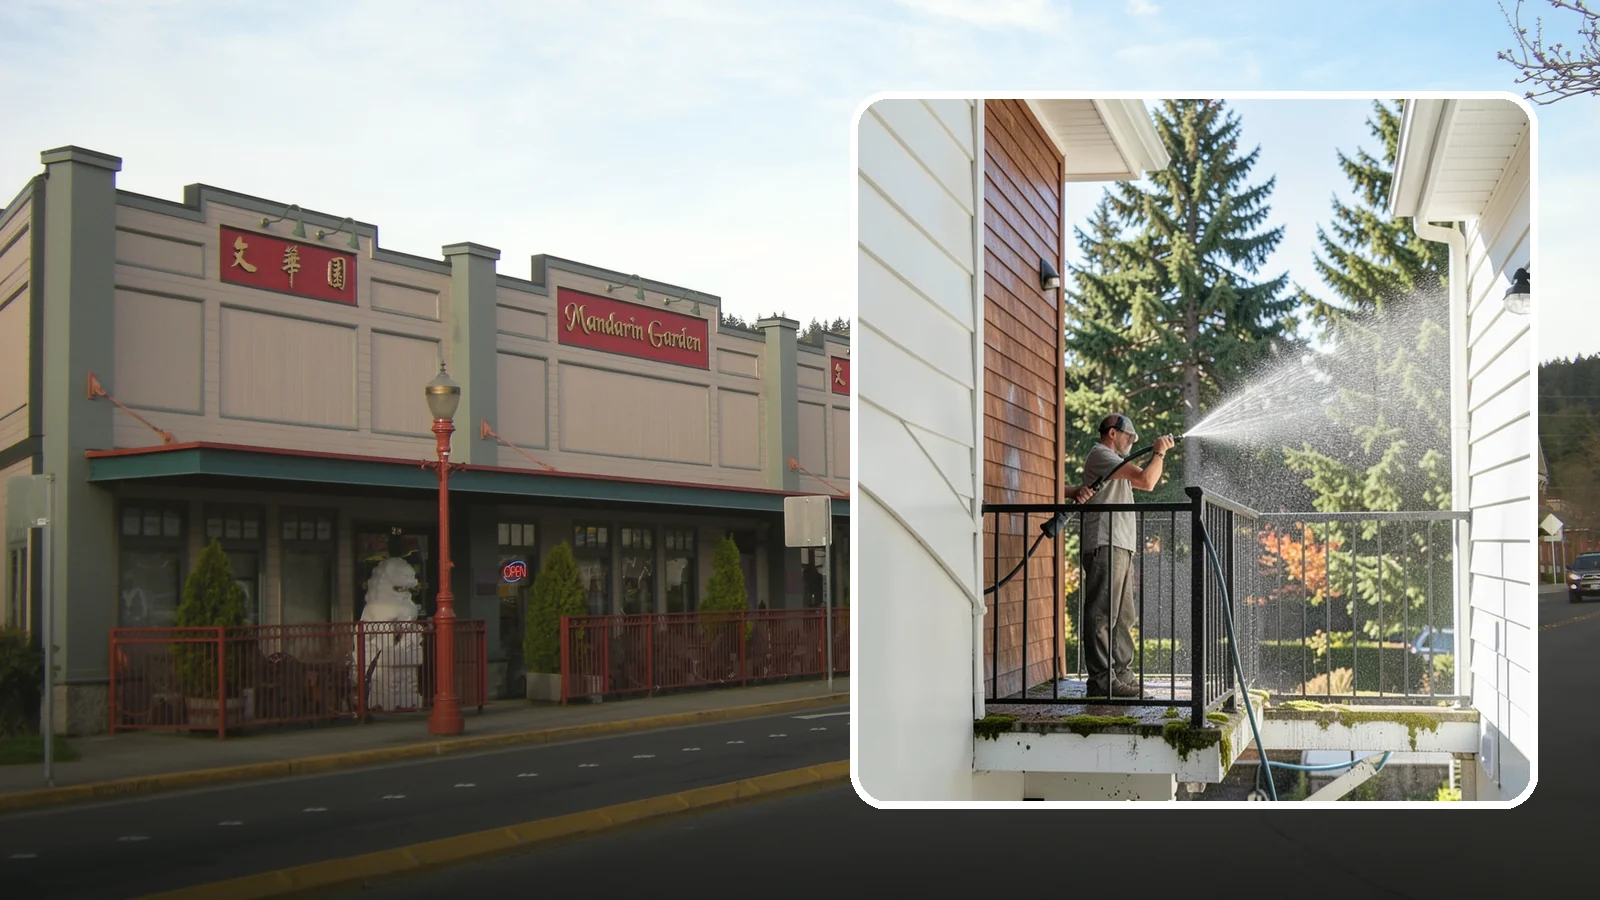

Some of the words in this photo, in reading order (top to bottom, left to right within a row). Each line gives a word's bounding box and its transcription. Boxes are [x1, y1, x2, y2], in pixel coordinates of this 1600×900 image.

[564, 302, 644, 341] Mandarin
[648, 320, 701, 352] Garden
[503, 565, 527, 578] OPEN
